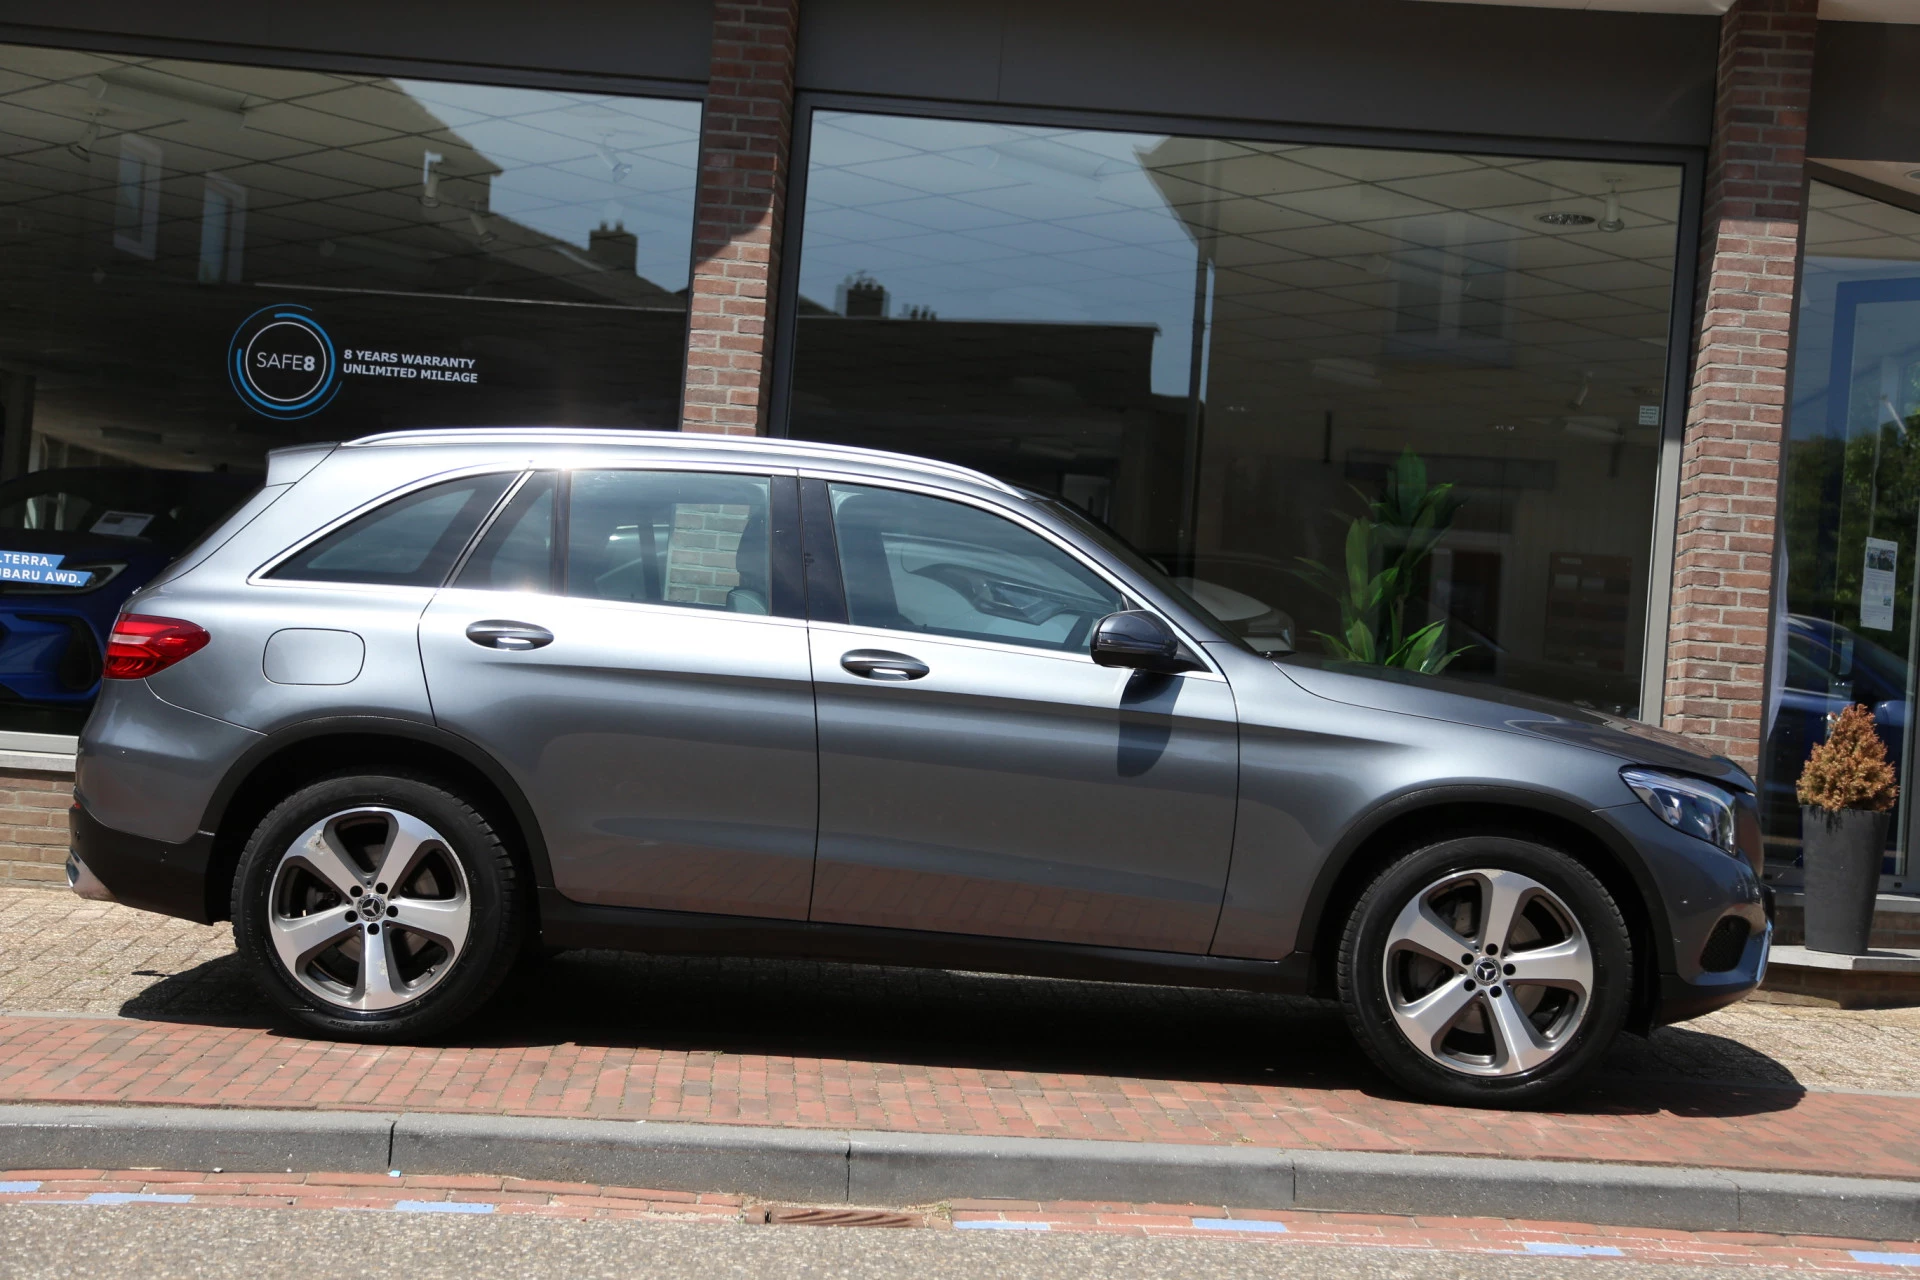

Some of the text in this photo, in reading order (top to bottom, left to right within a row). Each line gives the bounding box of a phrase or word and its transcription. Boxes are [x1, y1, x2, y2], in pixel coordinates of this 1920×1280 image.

[256, 351, 315, 371] SAFE8
[344, 349, 476, 369] 8 YEARS WARRANTY
[343, 363, 478, 383] UNLIMITED MILEAGE
[45, 571, 81, 584] AWD.
